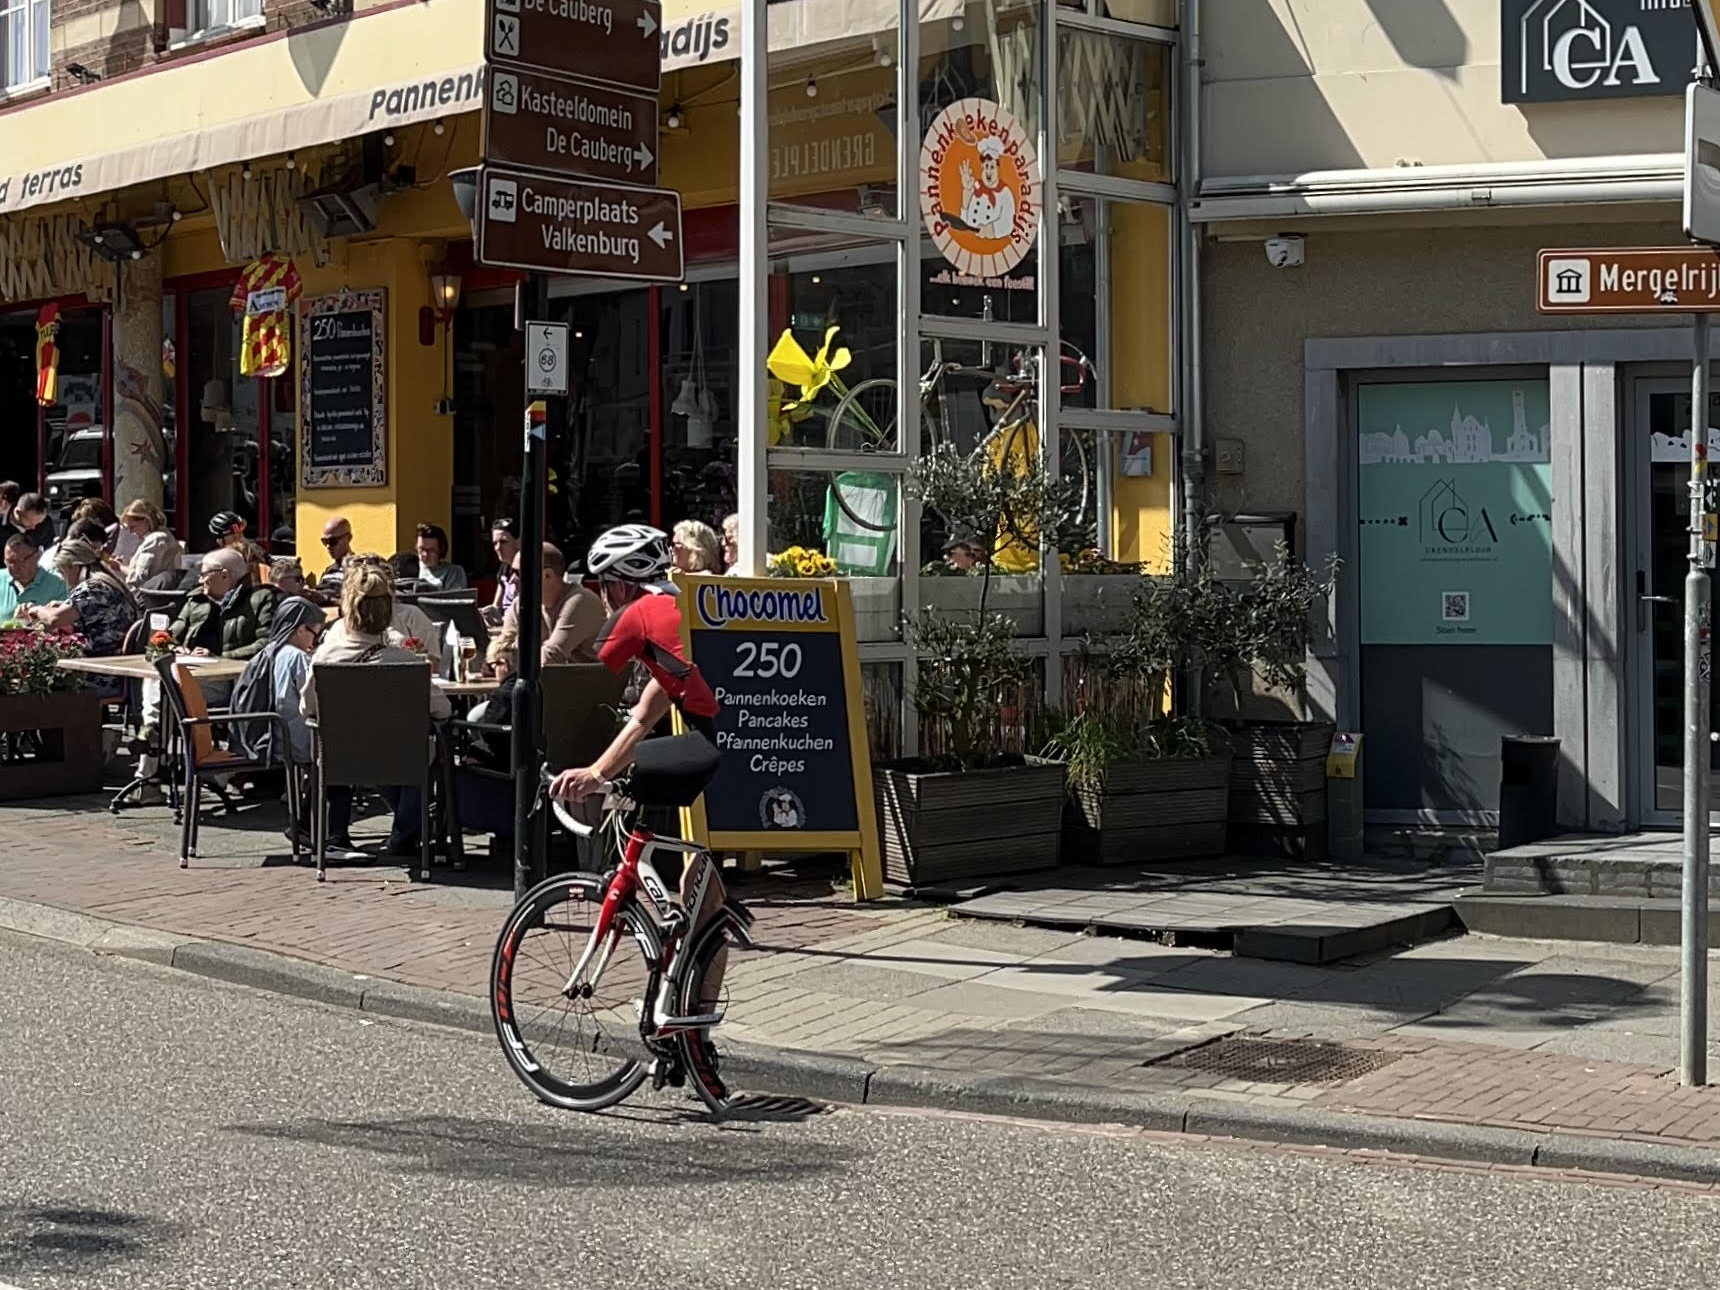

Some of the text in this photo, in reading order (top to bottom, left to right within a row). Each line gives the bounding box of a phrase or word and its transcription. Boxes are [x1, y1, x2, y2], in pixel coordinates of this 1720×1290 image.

[521, 84, 632, 130] Kasteeldomein
[547, 128, 632, 173] De Cauberg
[22, 161, 83, 199] terras
[522, 188, 638, 226] Camperplaats
[541, 224, 639, 264] Valkenburg
[312, 318, 336, 341] 250
[540, 354, 554, 366] 68
[698, 584, 828, 627] Chocomel
[732, 642, 802, 678] 250
[715, 687, 826, 706] Pannenkoeken
[738, 710, 808, 728] Pancakes
[716, 731, 833, 751] Pfannenkuchen
[750, 754, 805, 775] Crêpes
